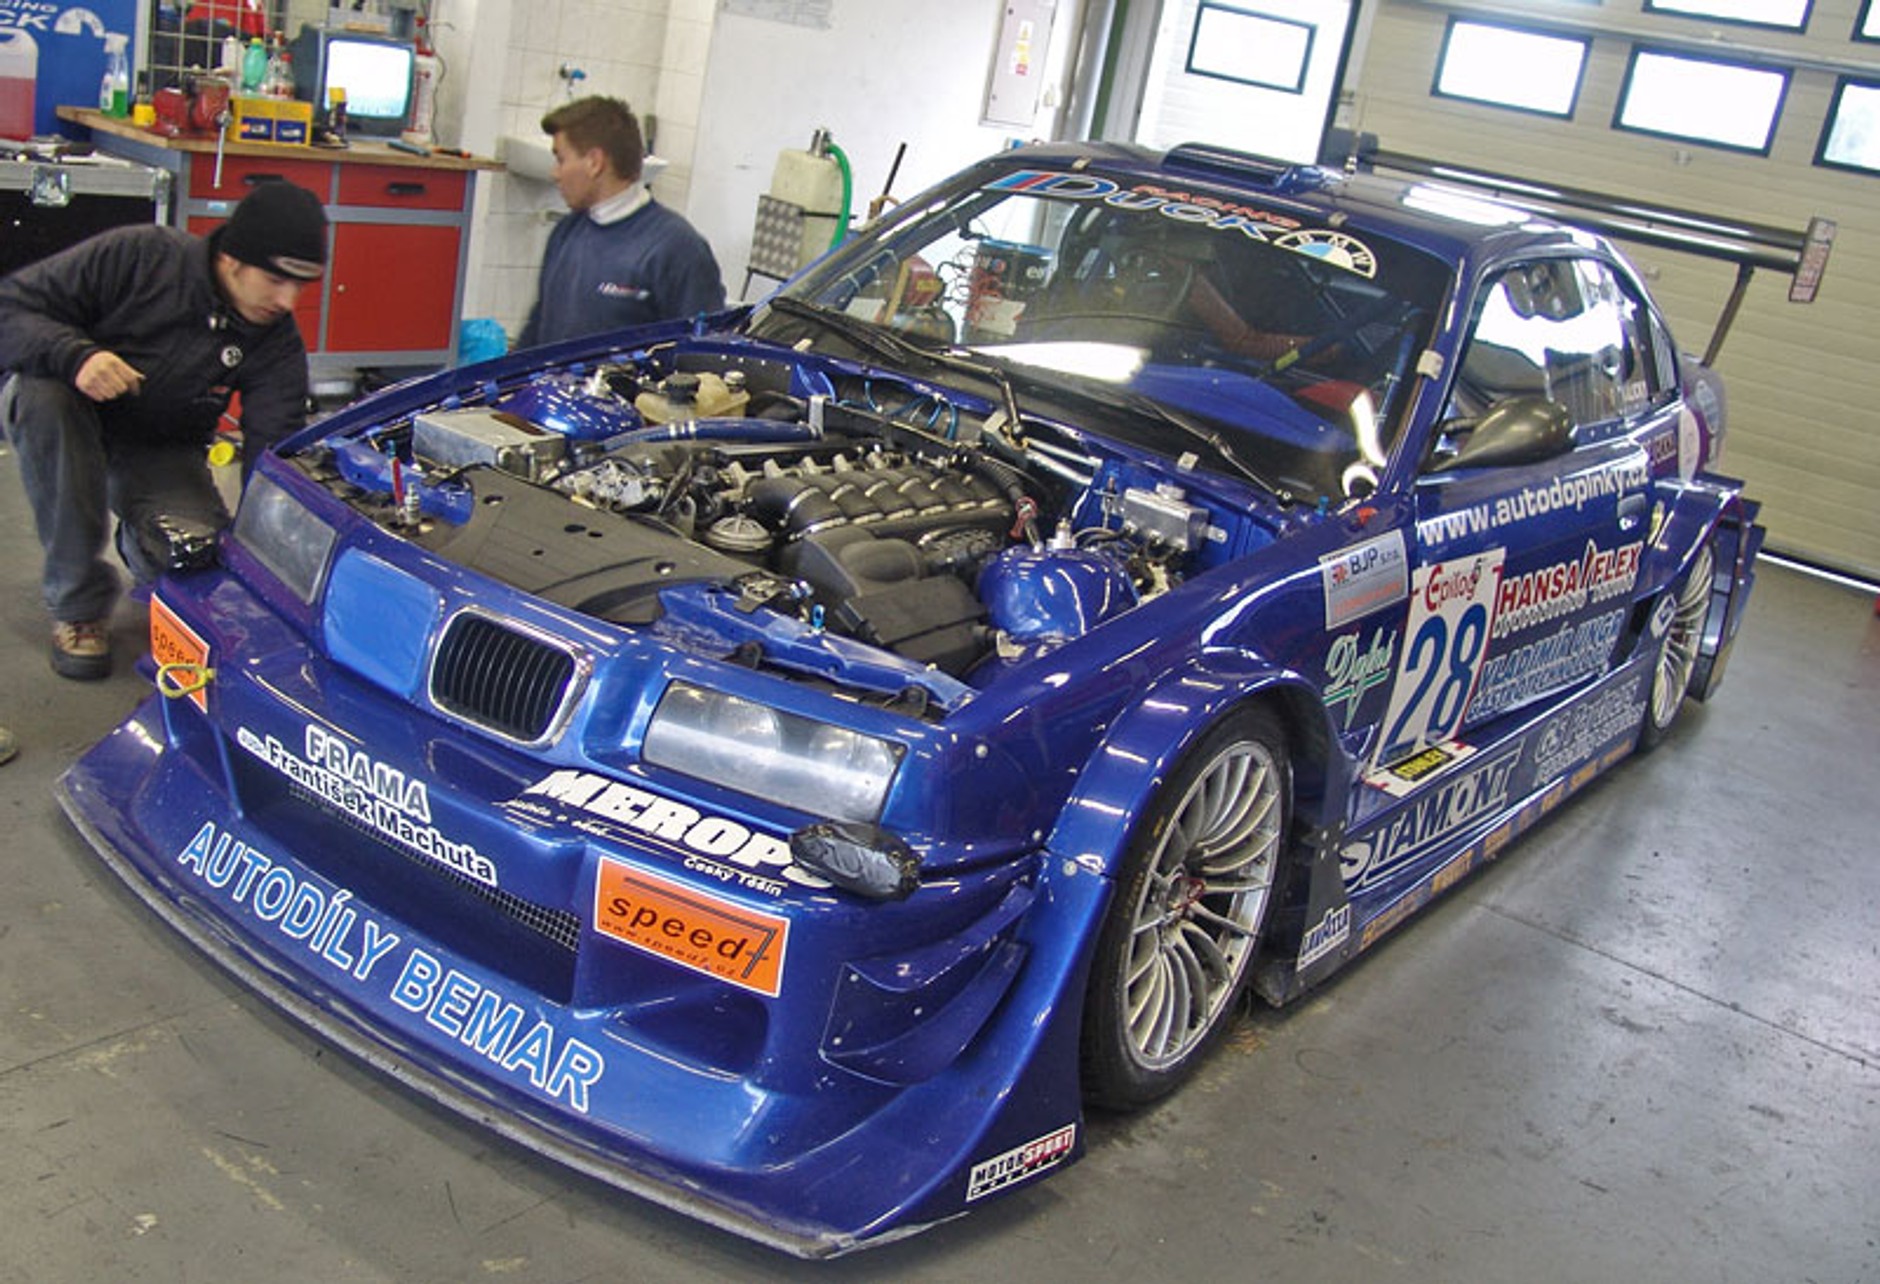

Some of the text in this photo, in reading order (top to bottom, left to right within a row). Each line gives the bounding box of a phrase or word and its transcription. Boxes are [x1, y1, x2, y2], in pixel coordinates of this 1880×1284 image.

[1348, 547, 1378, 575] BJP
[1499, 559, 1580, 617] HANSA
[1592, 541, 1643, 583] FLEX
[1374, 602, 1488, 769] 28
[265, 734, 373, 821] František
[374, 804, 497, 886] Machuta
[305, 724, 432, 822] FRAMA
[178, 821, 604, 1113] AUTODÍLY BEMAR
